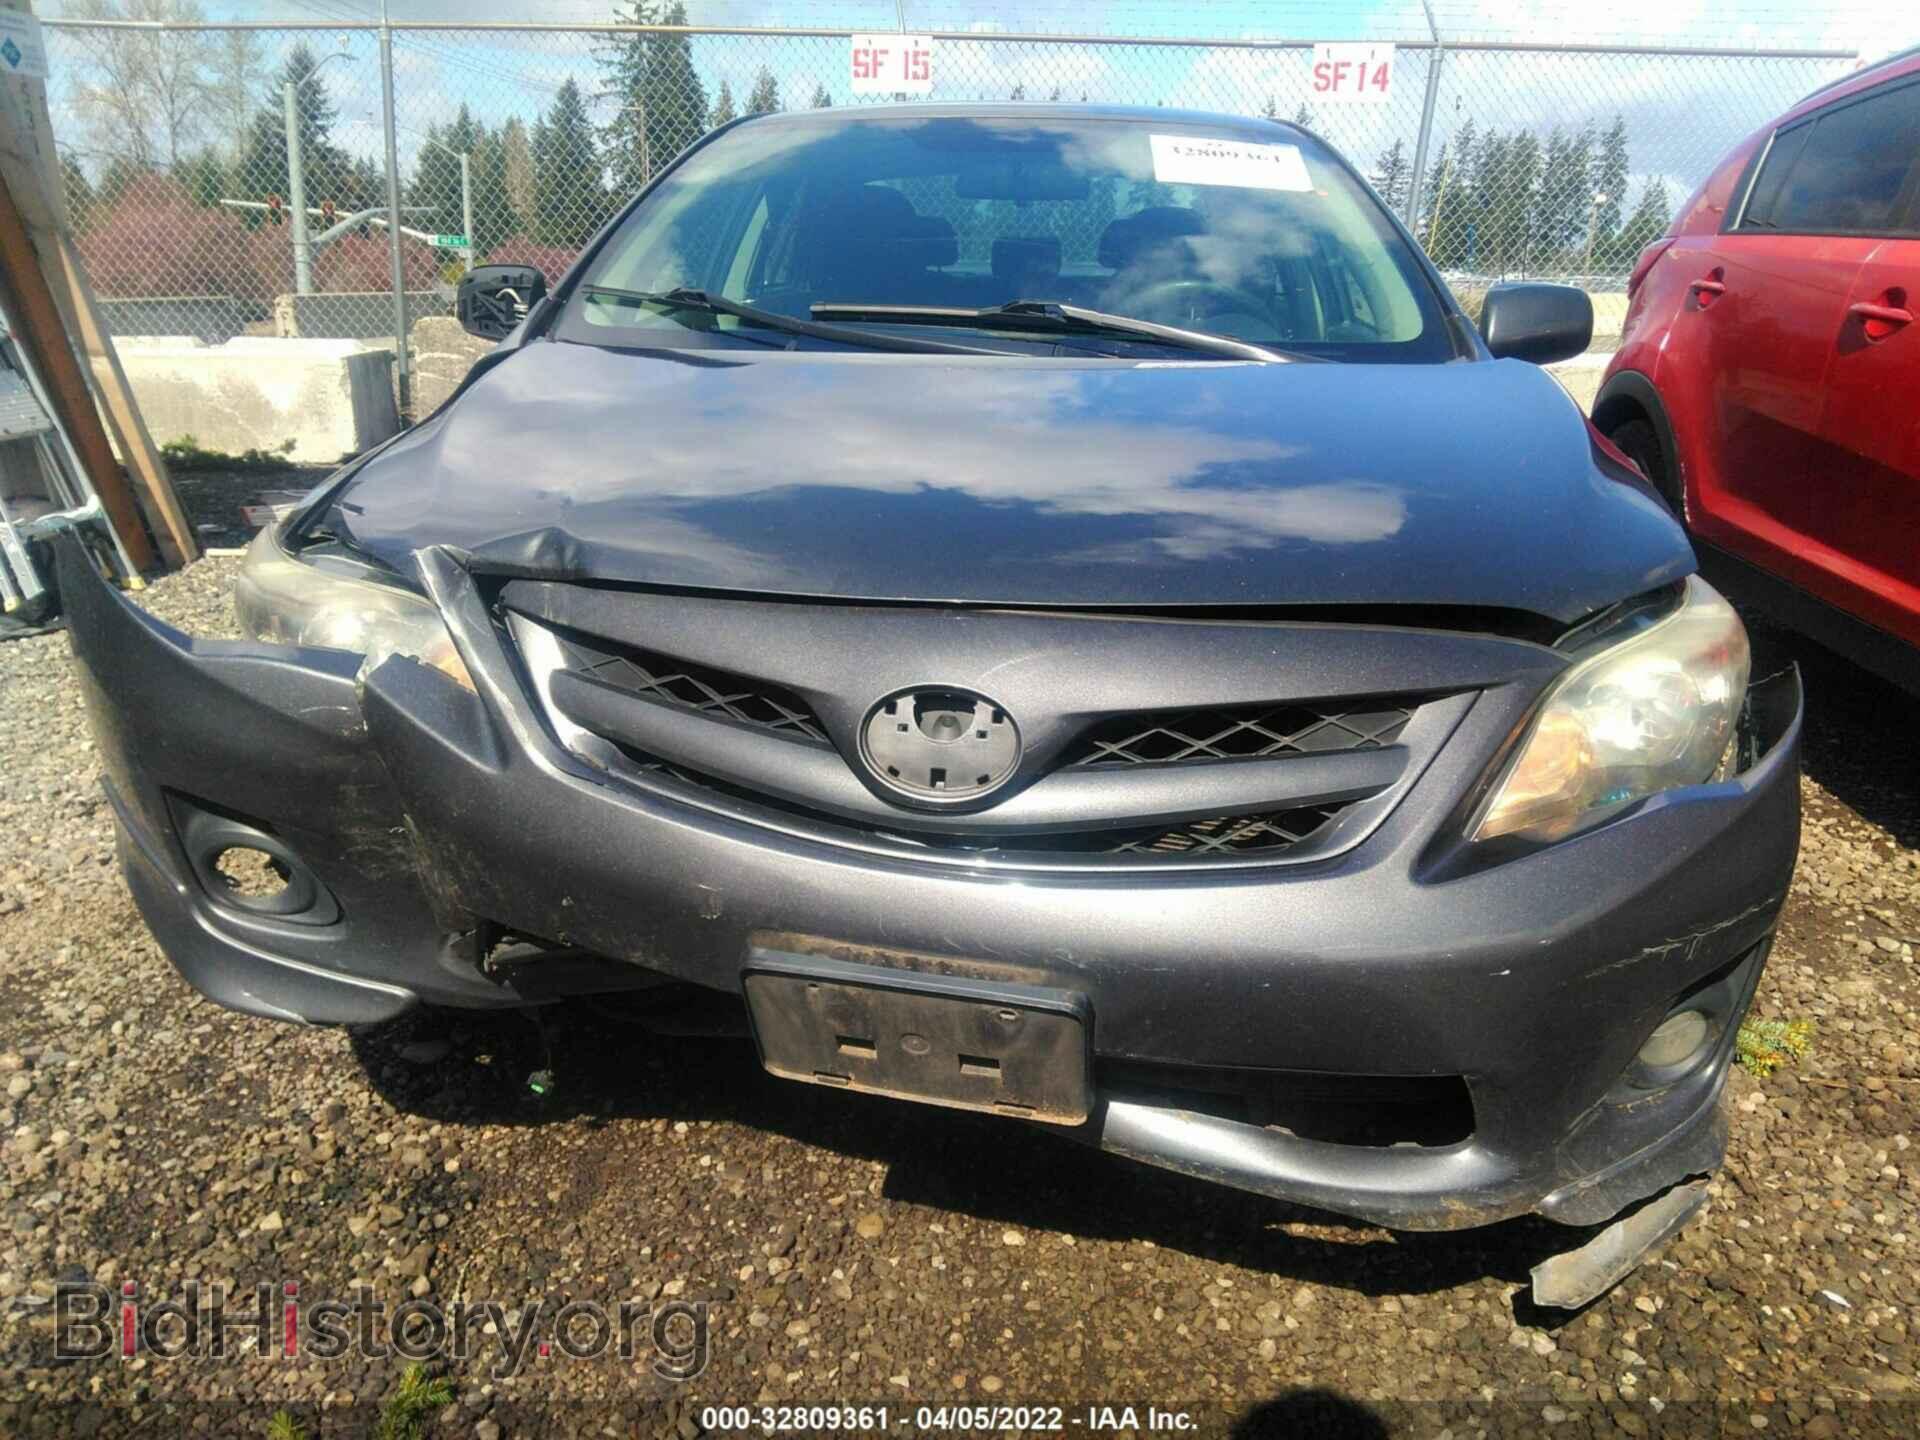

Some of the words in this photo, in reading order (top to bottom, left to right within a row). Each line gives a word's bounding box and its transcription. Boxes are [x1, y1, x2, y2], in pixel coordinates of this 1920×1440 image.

[853, 48, 889, 79] SF
[903, 49, 930, 81] 15
[1313, 61, 1352, 93] SF
[1357, 61, 1390, 93] 14
